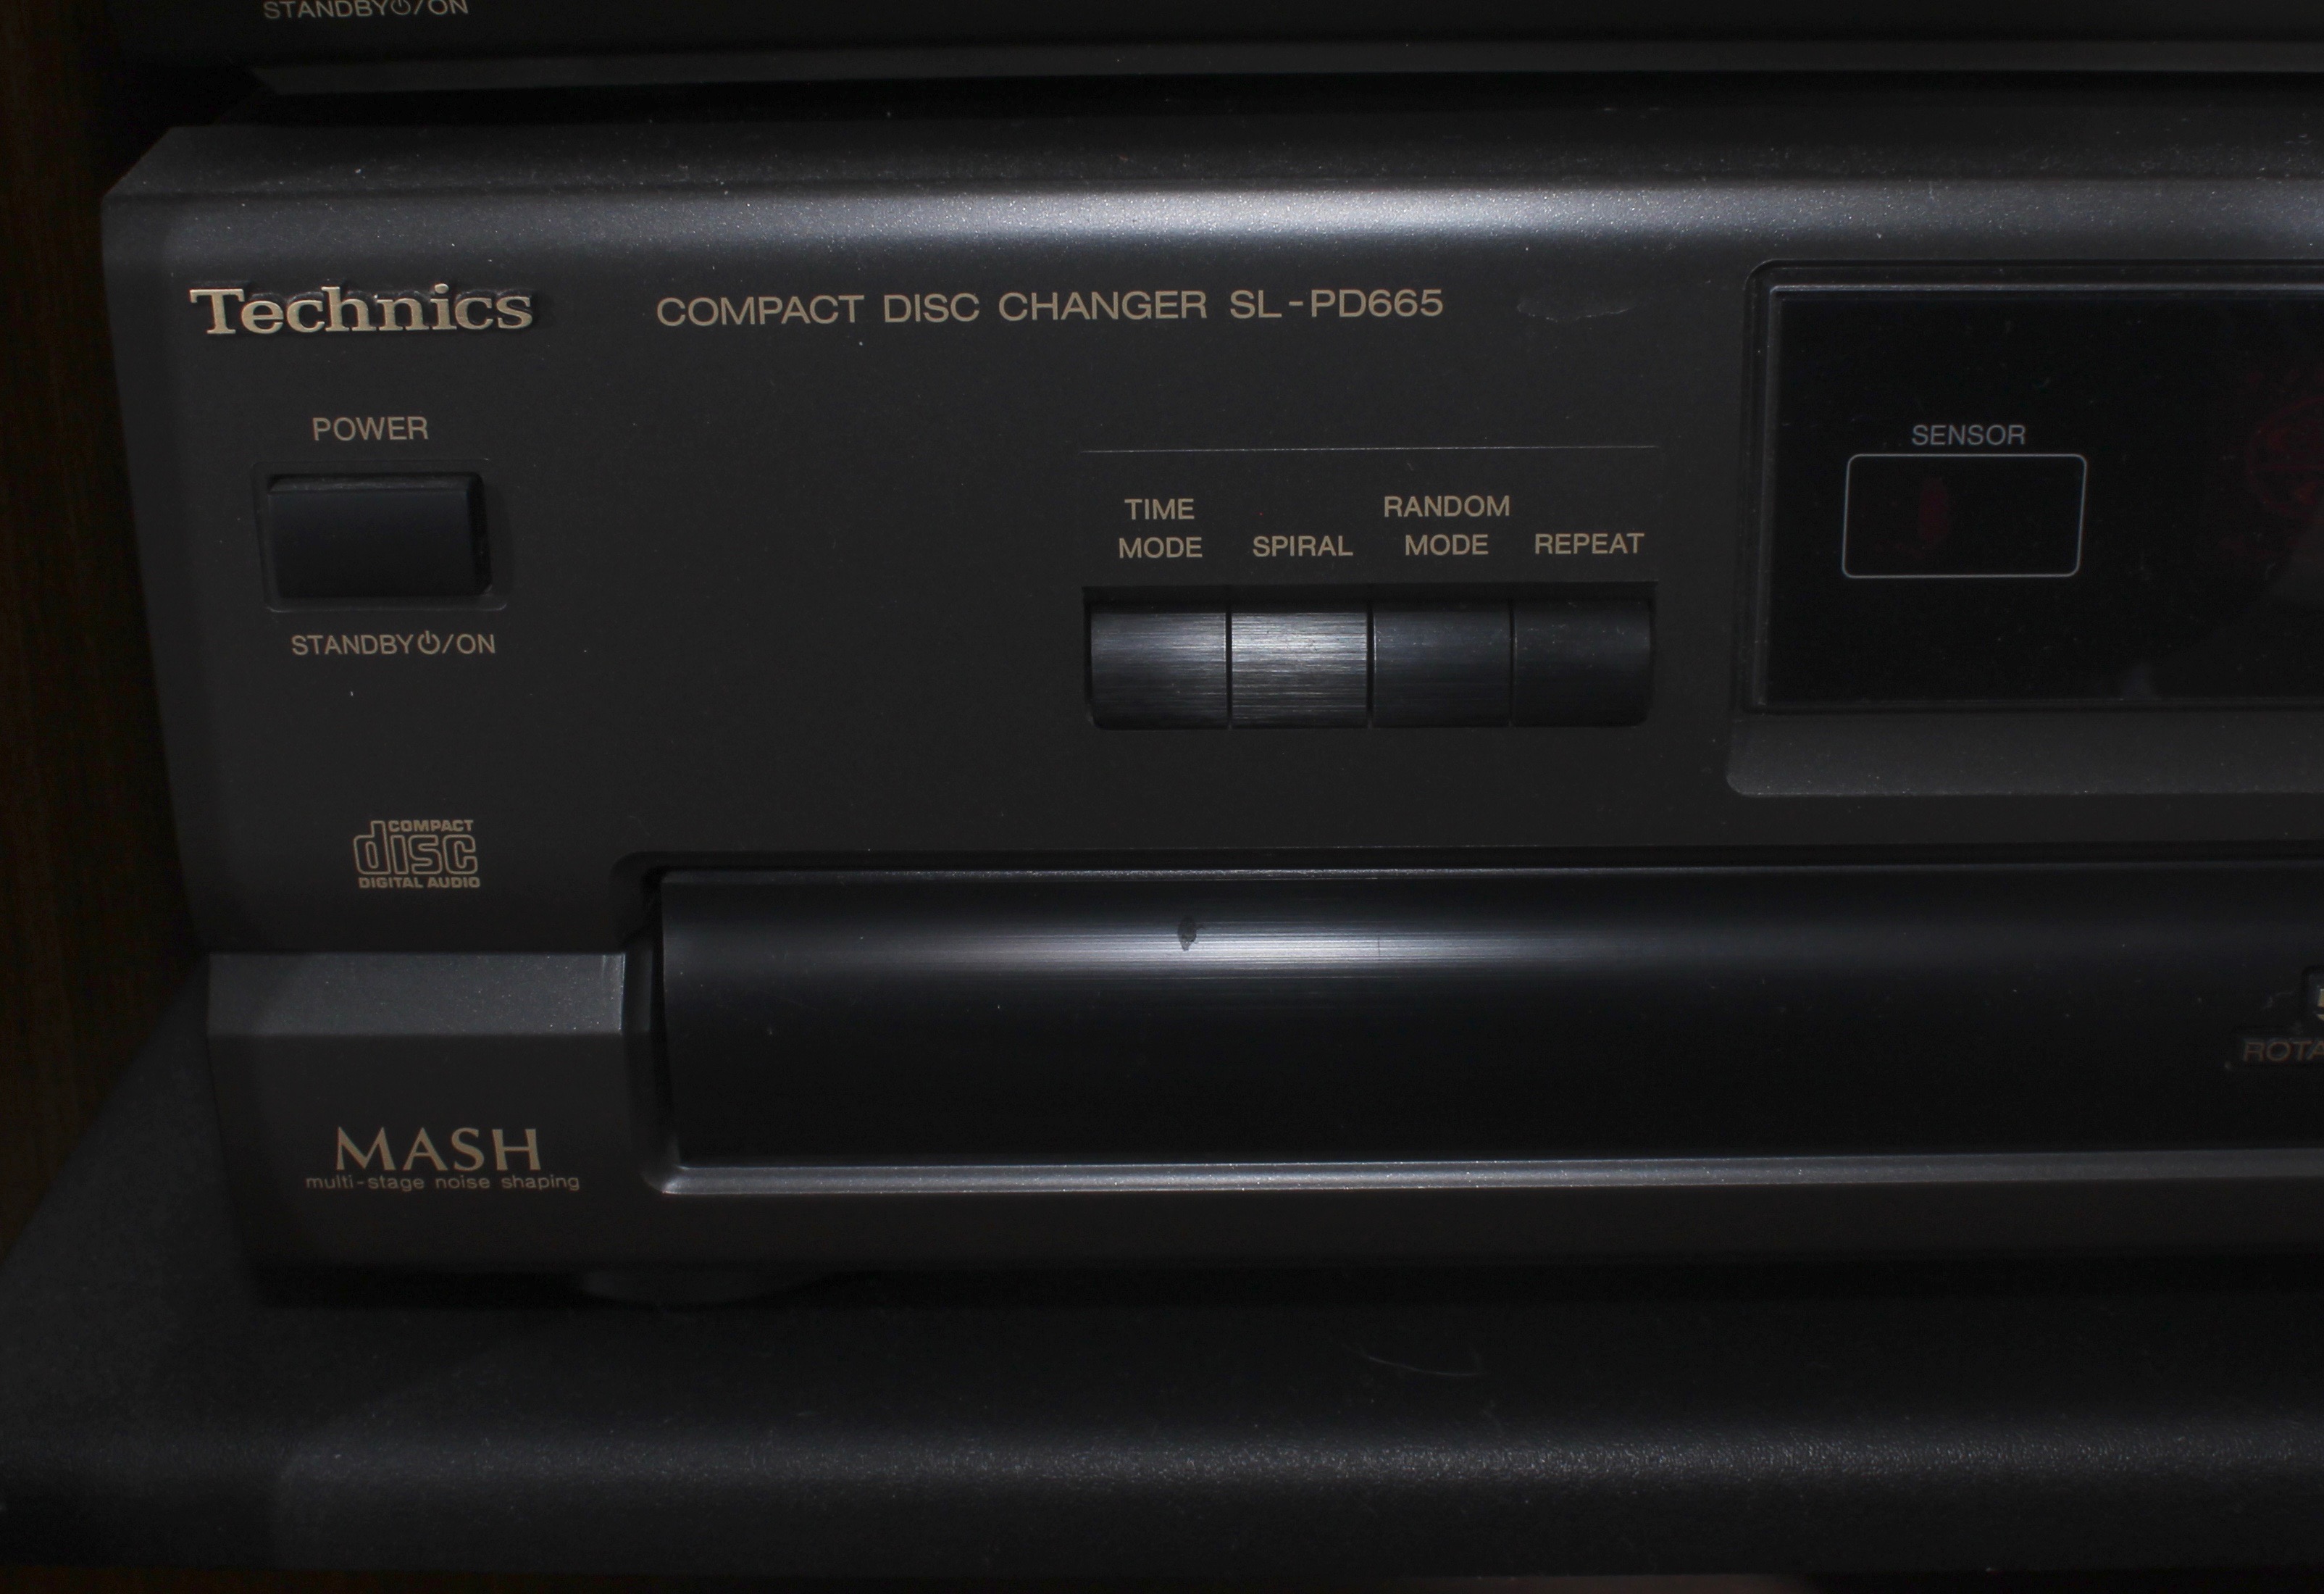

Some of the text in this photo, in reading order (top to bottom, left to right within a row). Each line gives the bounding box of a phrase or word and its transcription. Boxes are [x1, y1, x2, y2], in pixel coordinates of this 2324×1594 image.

[189, 283, 533, 335] Technics
[656, 289, 1444, 327] COMPACT DISC CHANGER SL-PD665
[312, 417, 429, 441] POWER
[1911, 425, 2026, 446] SENSOR
[1124, 498, 1195, 520] TIME
[1384, 496, 1510, 517] RANDOM
[1119, 537, 1203, 559] MODE
[1253, 535, 1353, 557] SPIRAL
[1405, 534, 1489, 556] MODE
[1534, 533, 1645, 555] REPEAT
[388, 819, 475, 833] COMPACT
[359, 877, 481, 889] DIGITAL AUDIO
[336, 1126, 542, 1172] MASH
[305, 1174, 580, 1192] multi-stage noise shaping
